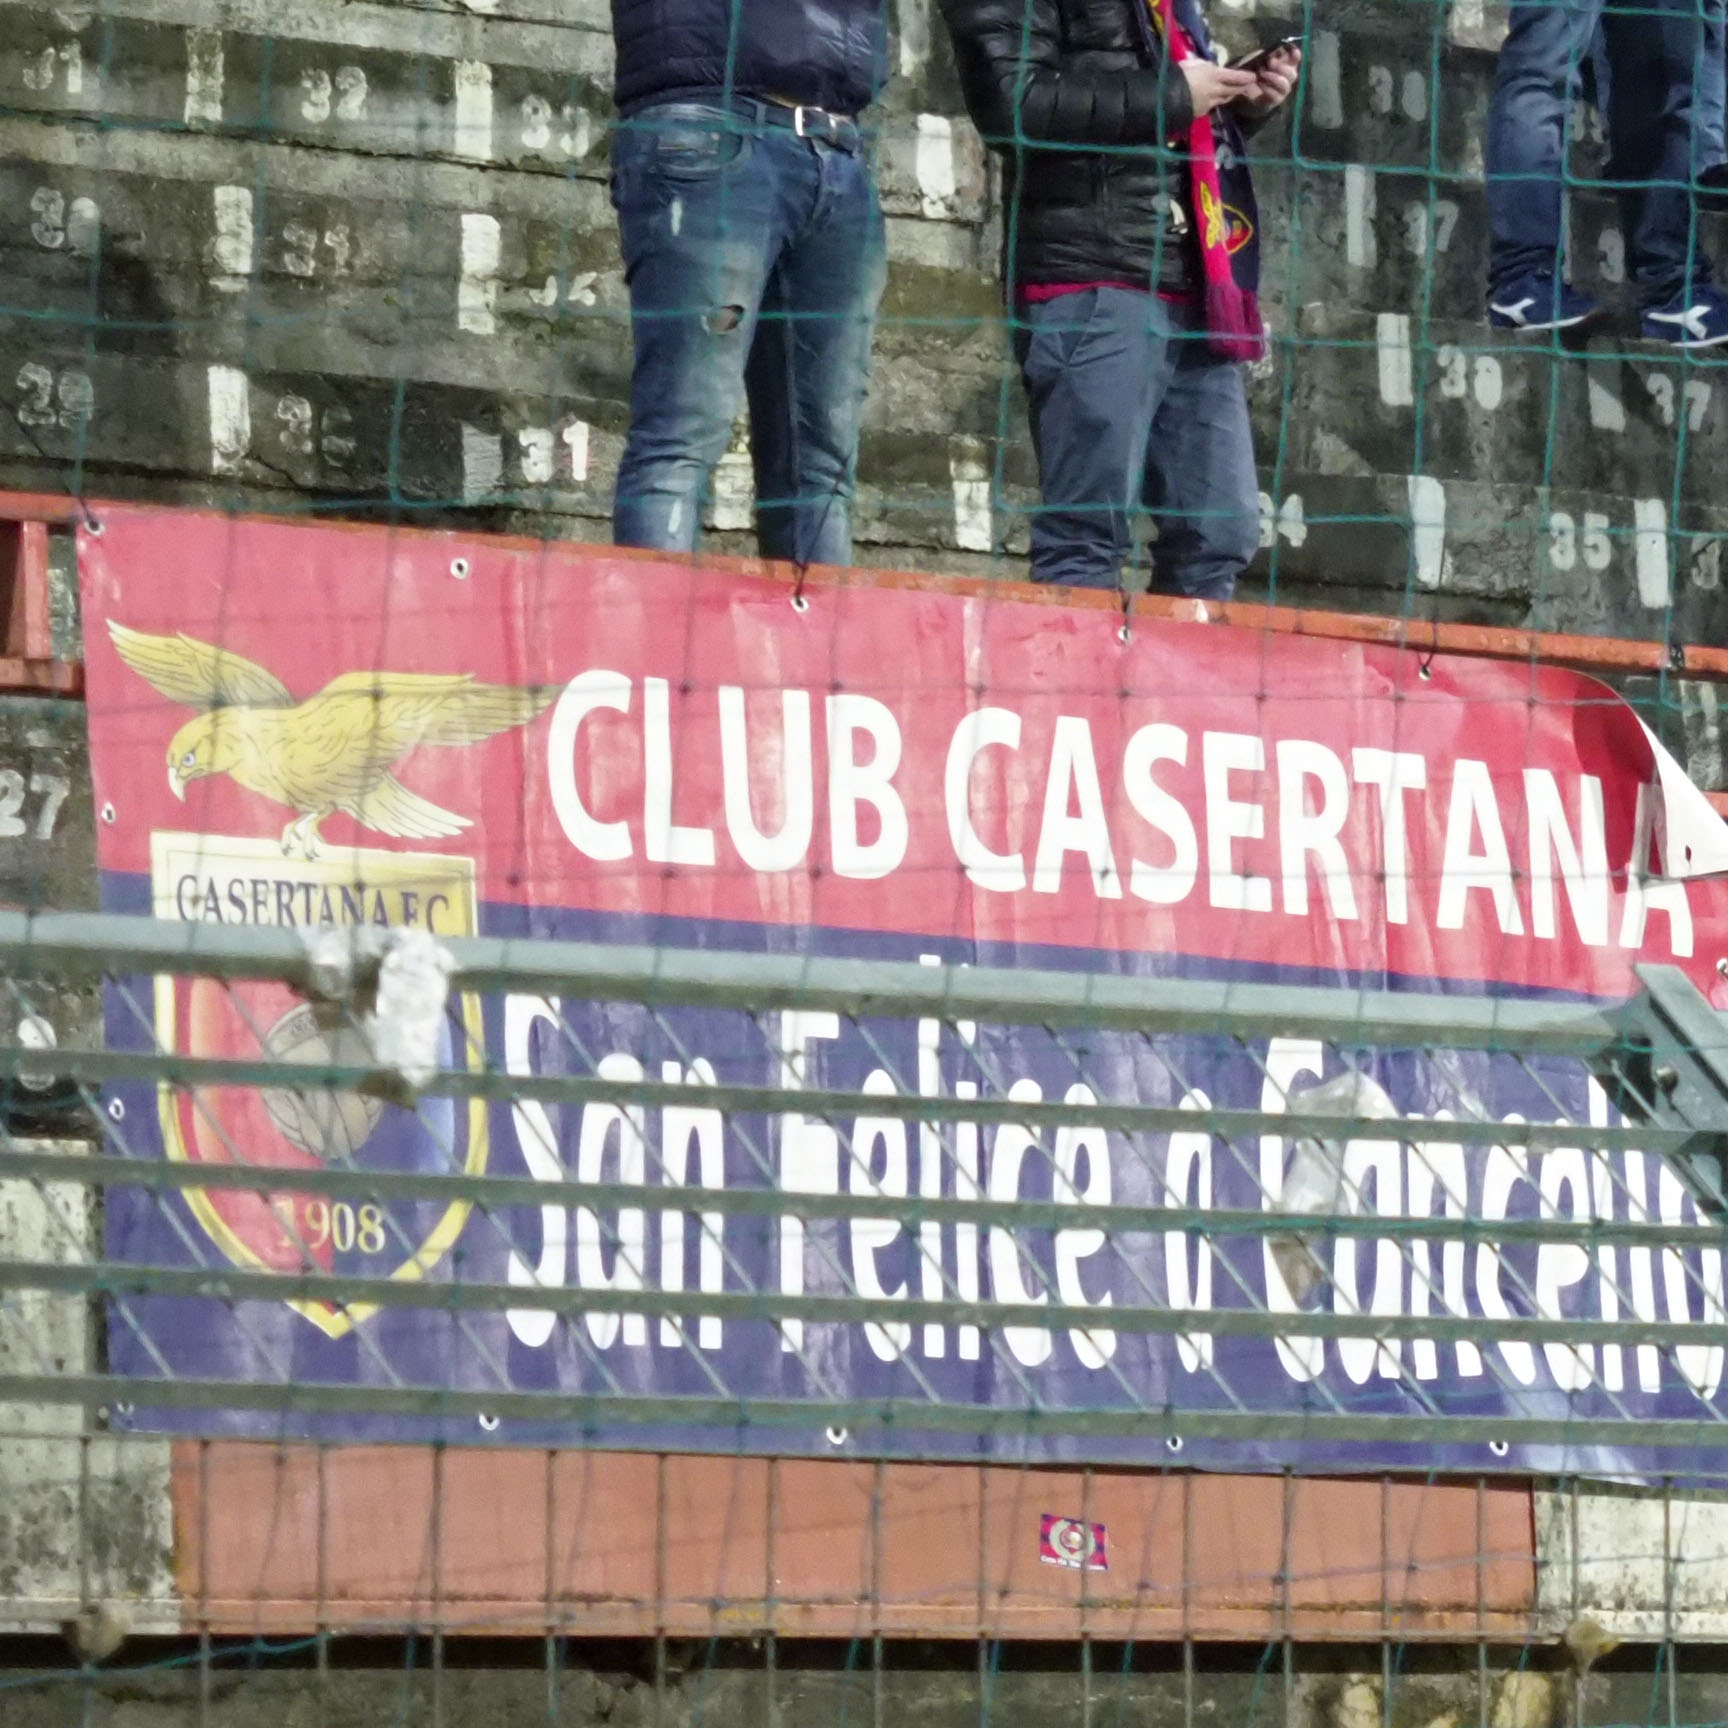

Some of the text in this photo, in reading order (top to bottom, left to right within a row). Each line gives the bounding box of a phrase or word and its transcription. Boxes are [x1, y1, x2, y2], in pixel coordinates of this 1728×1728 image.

[518, 421, 589, 483] 31
[1550, 512, 1612, 571] 35
[547, 669, 1694, 958] CLUB CASERTANA
[177, 874, 388, 927] CASERTANA
[504, 990, 723, 1352] San
[781, 955, 1112, 1370] Felice
[277, 1197, 386, 1254] 1908
